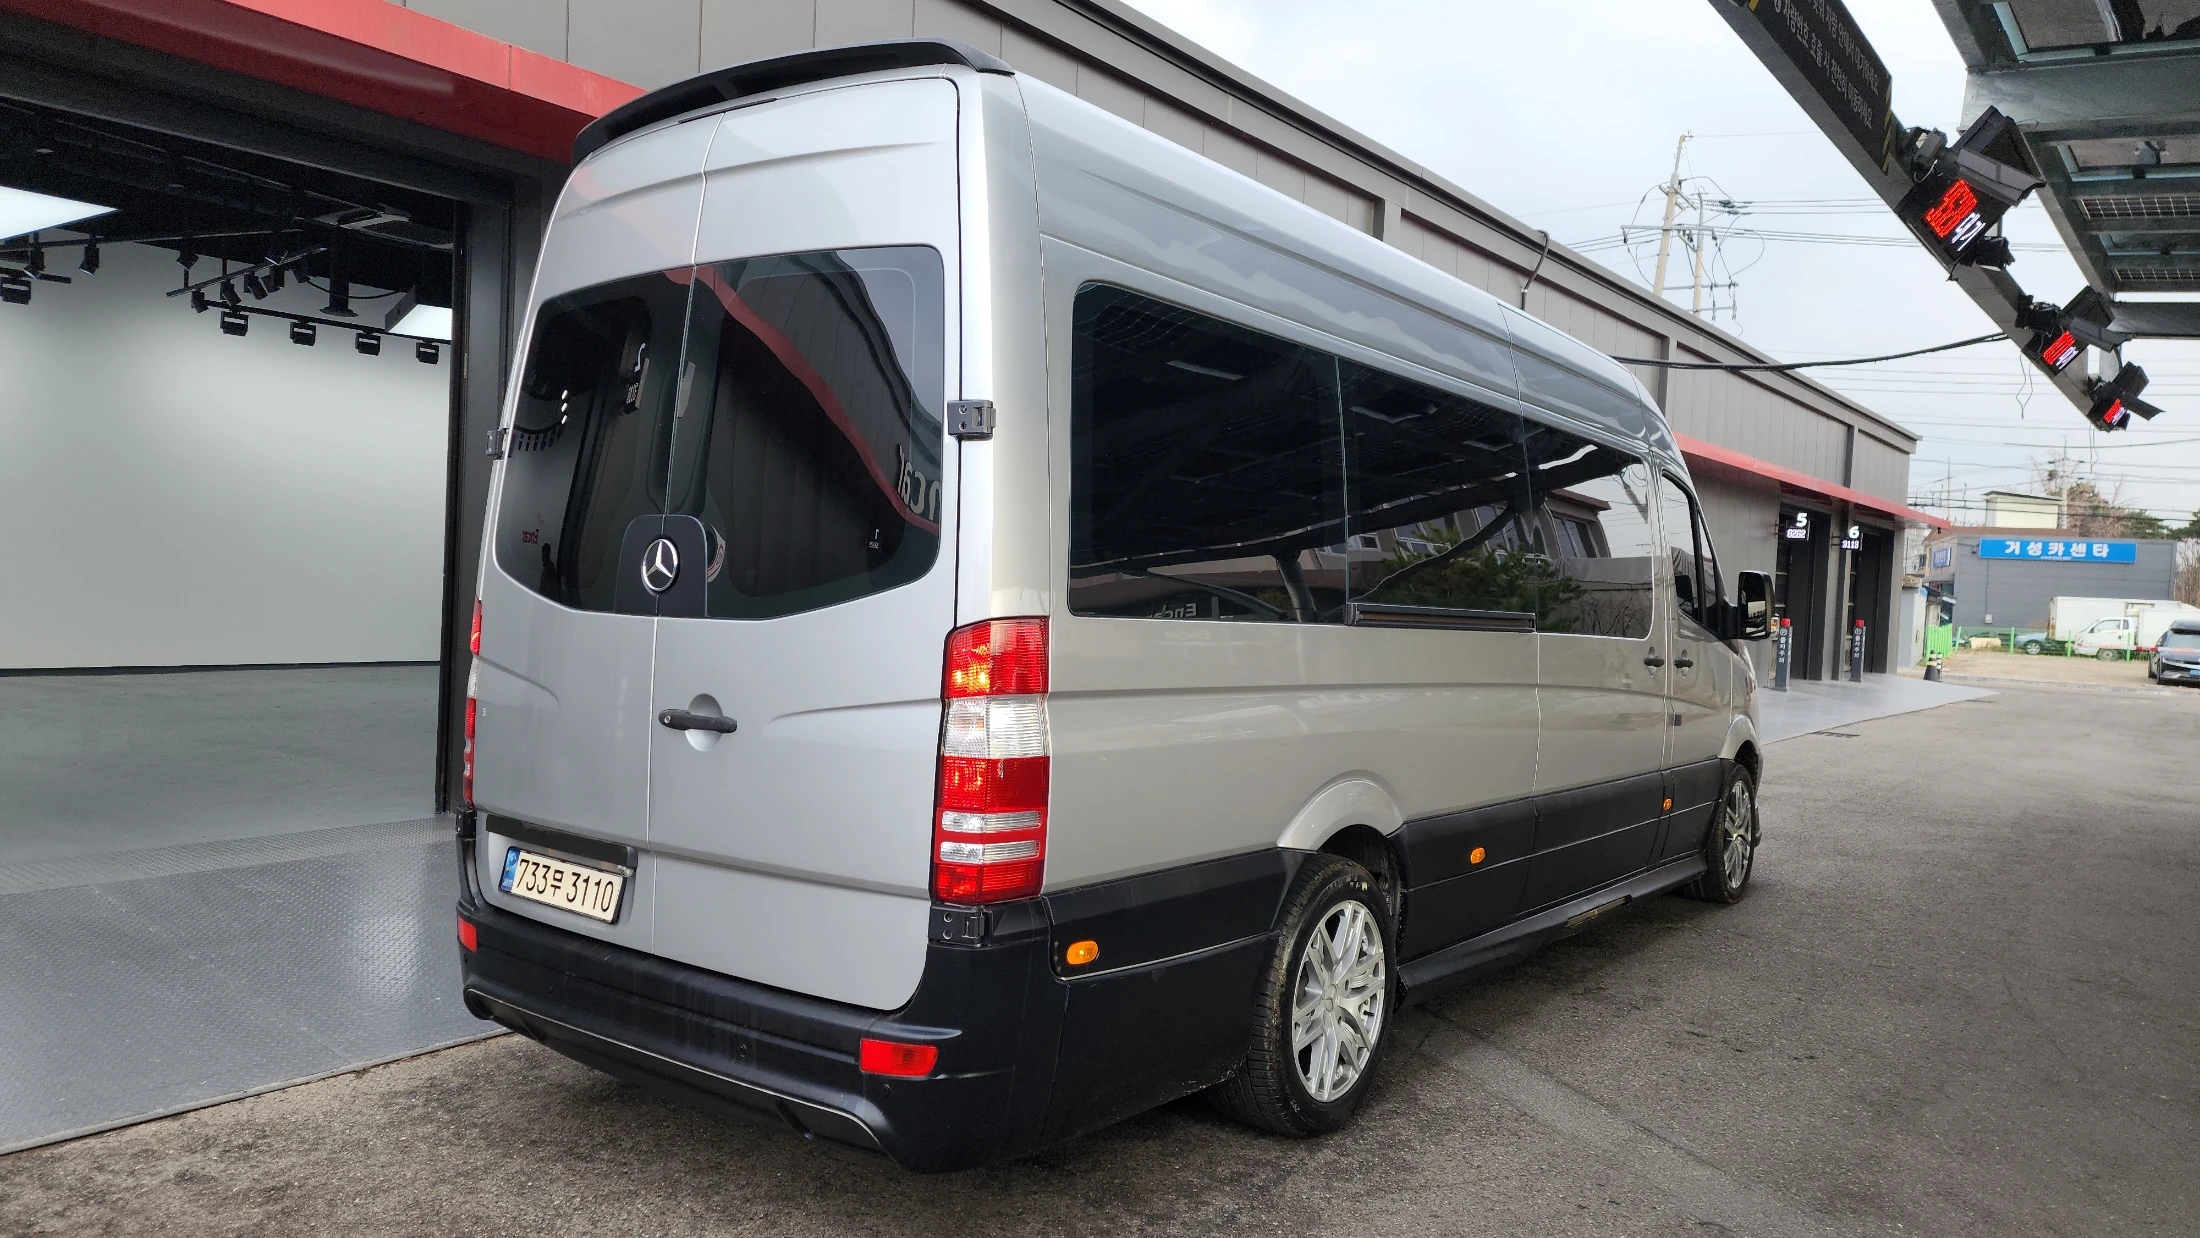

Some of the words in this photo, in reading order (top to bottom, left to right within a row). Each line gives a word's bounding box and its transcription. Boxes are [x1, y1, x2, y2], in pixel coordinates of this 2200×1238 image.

[1810, 32, 1823, 67] 호출
[1824, 50, 1830, 77] 시
[1952, 212, 1986, 251] 대기
[1796, 512, 1808, 527] 5
[1849, 525, 1860, 539] 6
[2005, 541, 2110, 558] 거성카센타
[516, 858, 565, 897] 733무
[566, 871, 614, 912] 3110
